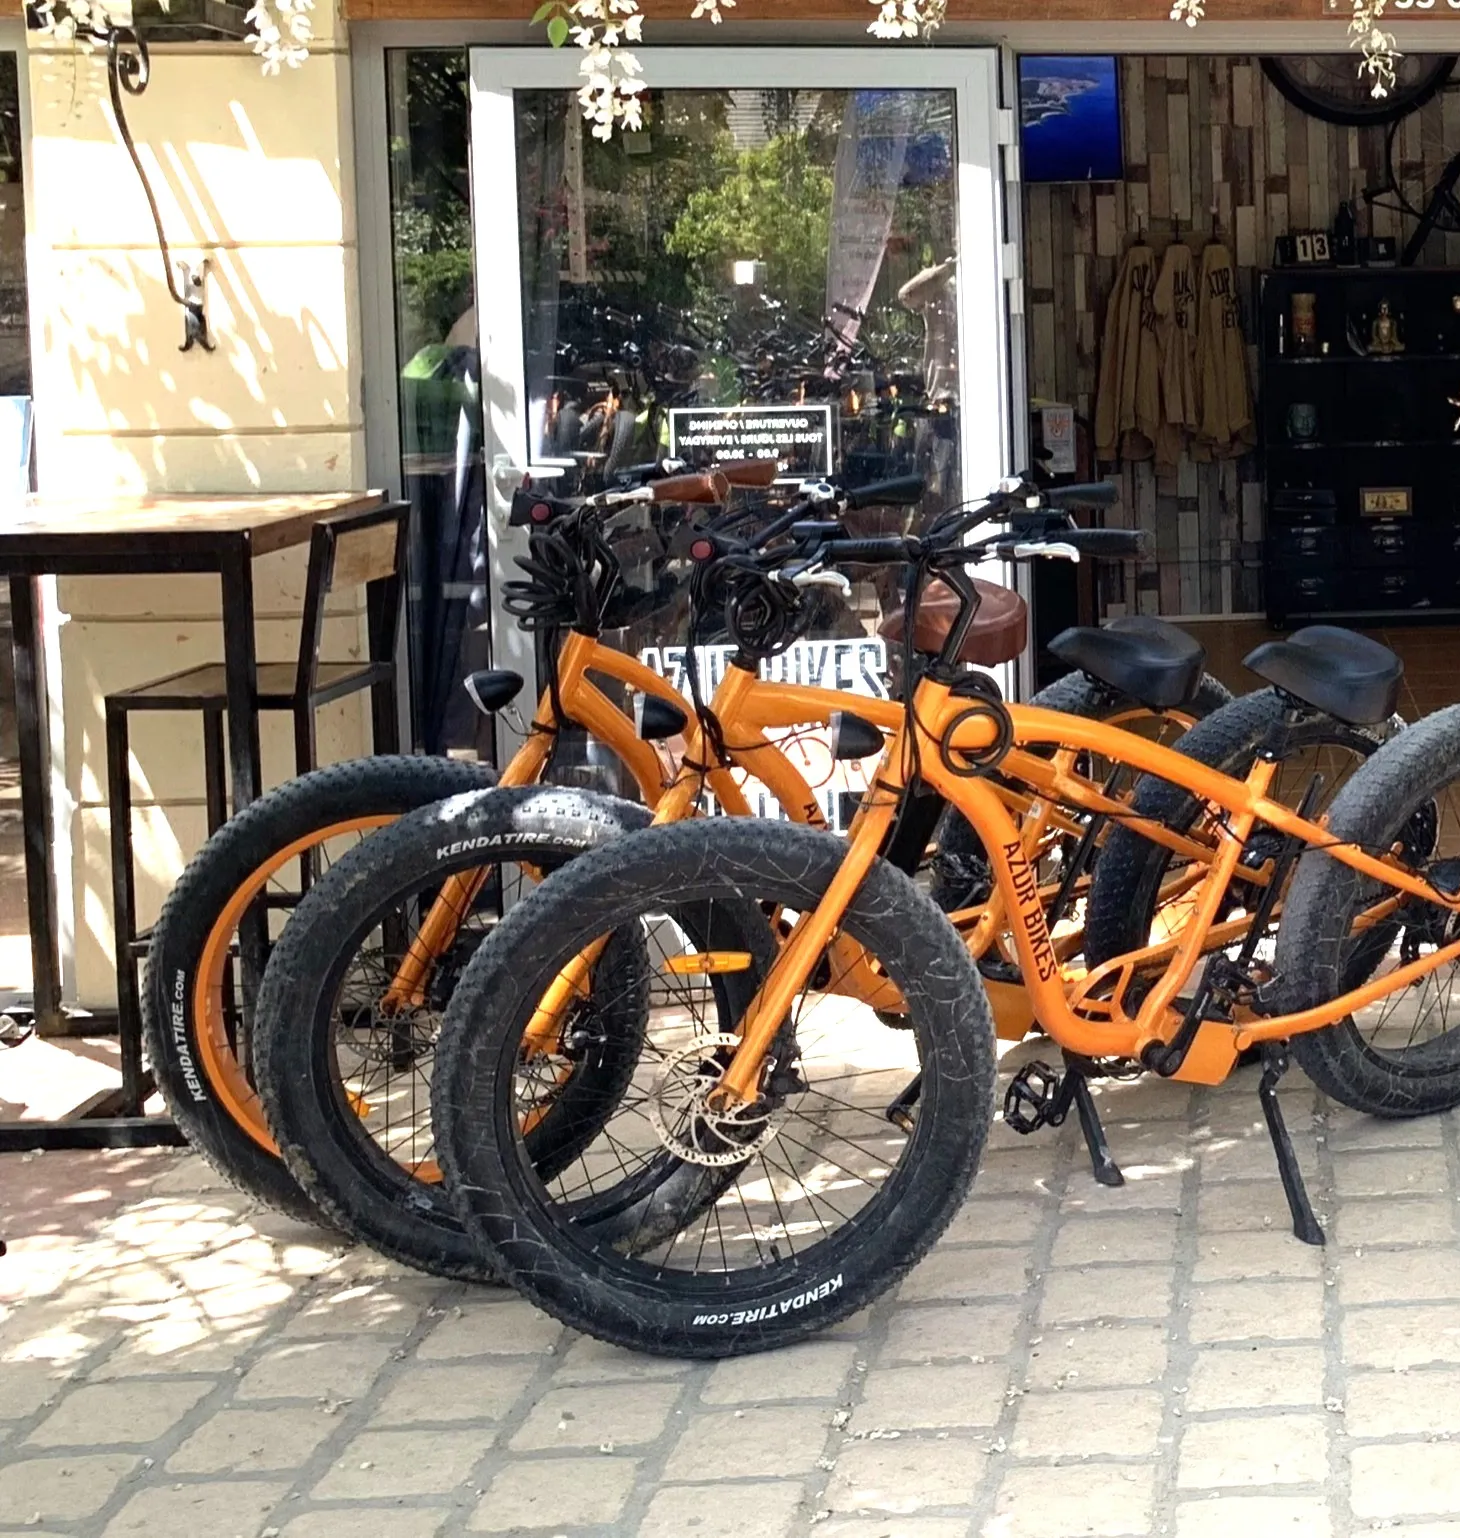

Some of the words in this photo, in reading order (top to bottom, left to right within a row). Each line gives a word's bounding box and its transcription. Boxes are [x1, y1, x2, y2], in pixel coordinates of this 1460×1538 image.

[1299, 237, 1327, 259] 13
[1003, 840, 1036, 906] AZUR
[1023, 911, 1057, 982] BIKES
[172, 968, 208, 1102] KENDATIRE.COM
[692, 1273, 844, 1326] KENDATIRE.COM
